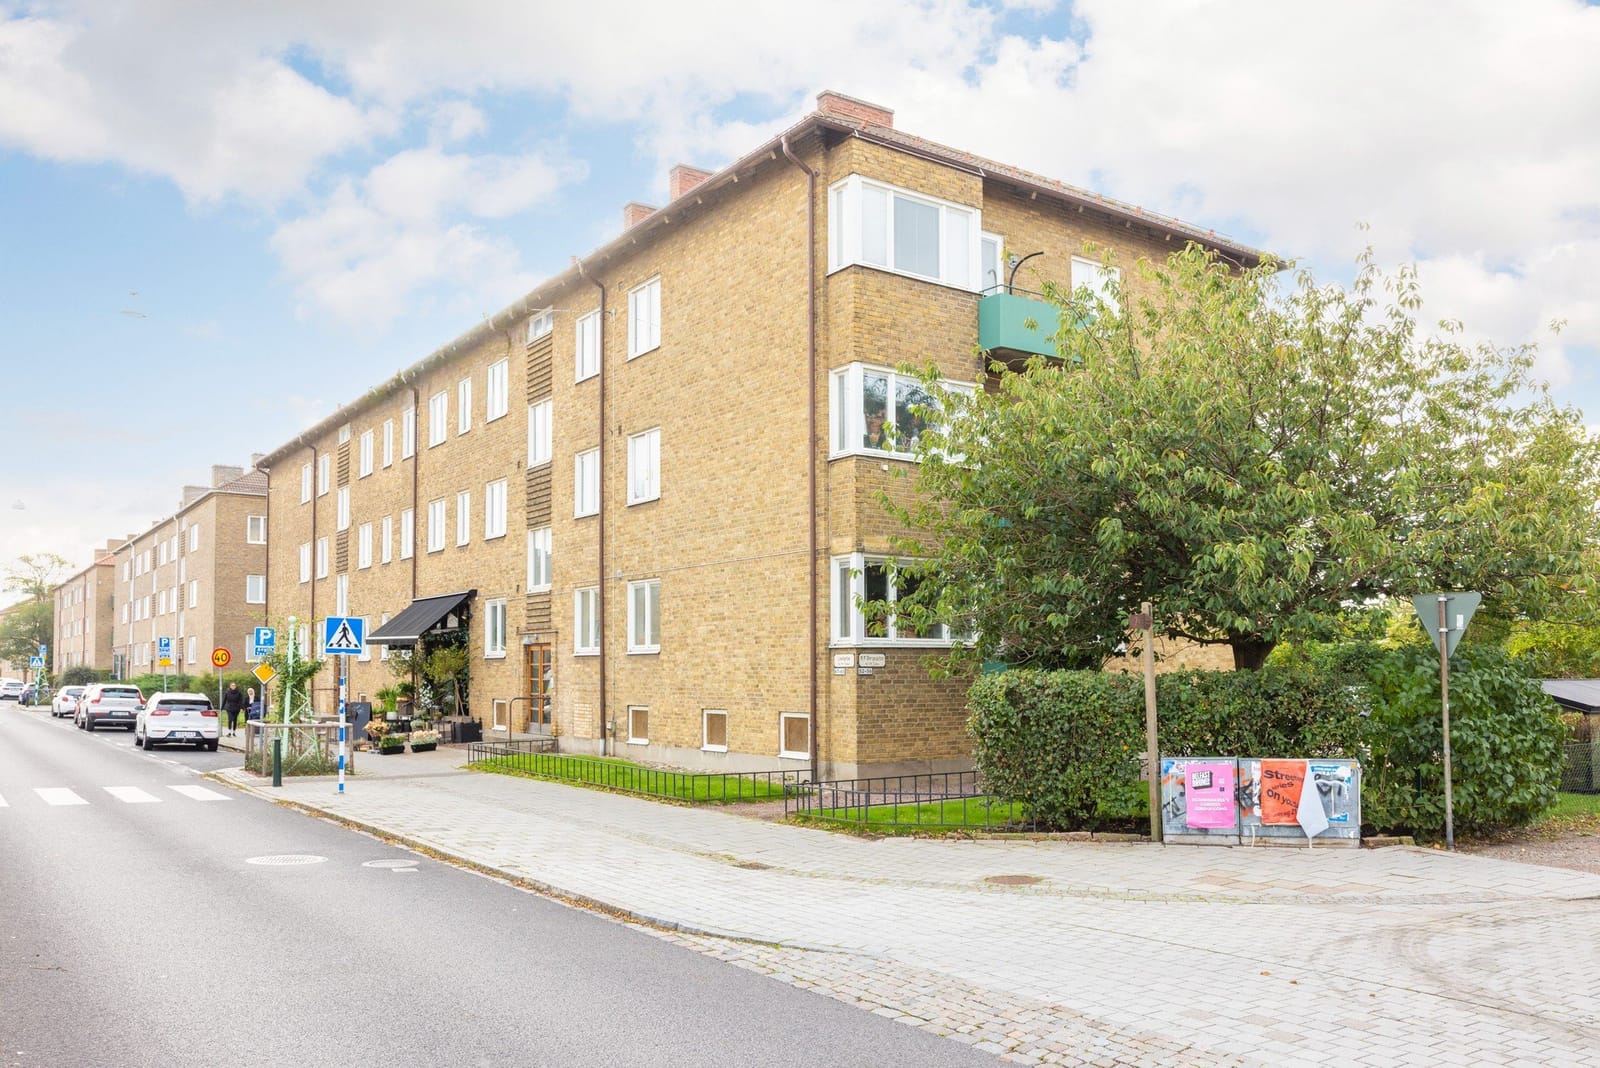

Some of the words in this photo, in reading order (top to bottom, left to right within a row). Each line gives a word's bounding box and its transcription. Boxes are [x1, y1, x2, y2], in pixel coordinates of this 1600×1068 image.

[161, 638, 169, 647] P
[259, 629, 272, 645] P
[214, 652, 228, 663] 40
